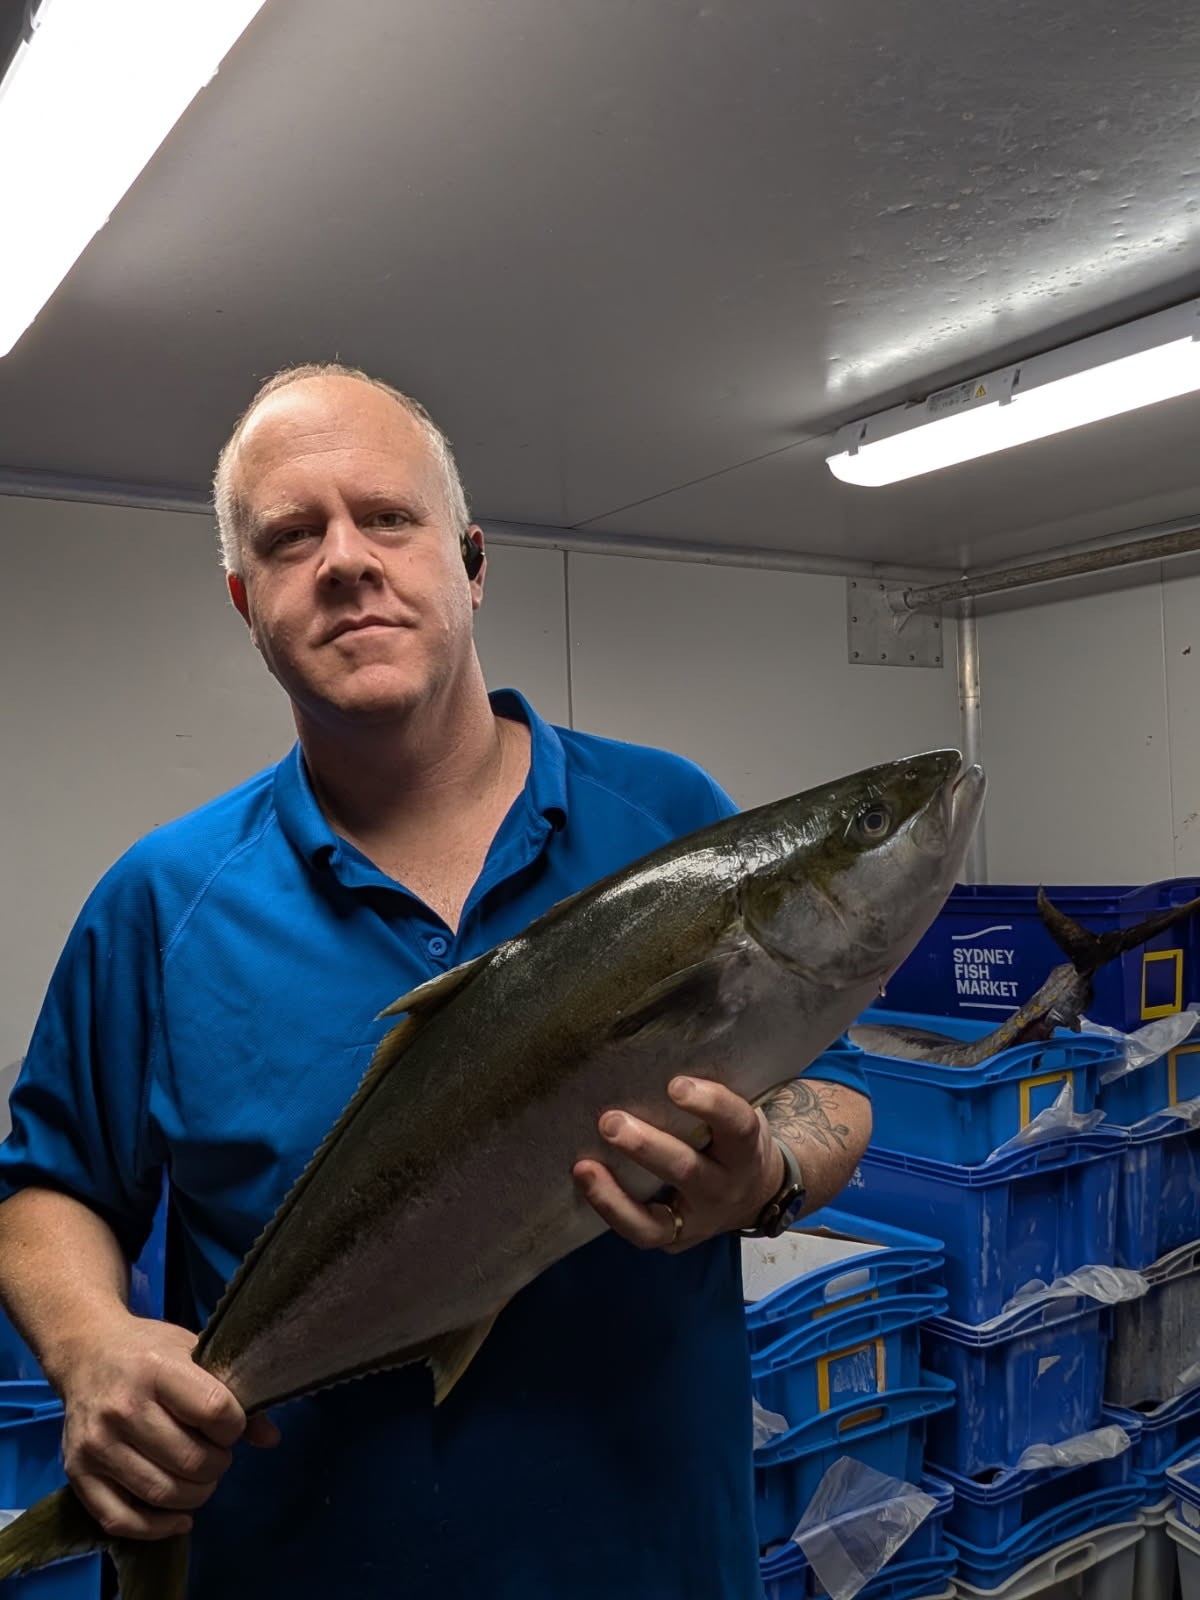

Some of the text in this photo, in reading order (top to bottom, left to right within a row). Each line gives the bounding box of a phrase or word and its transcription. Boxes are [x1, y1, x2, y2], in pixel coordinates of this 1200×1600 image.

[953, 948, 1014, 964] SYDNEY
[954, 964, 990, 979] FISH
[956, 980, 1018, 997] MARKET
